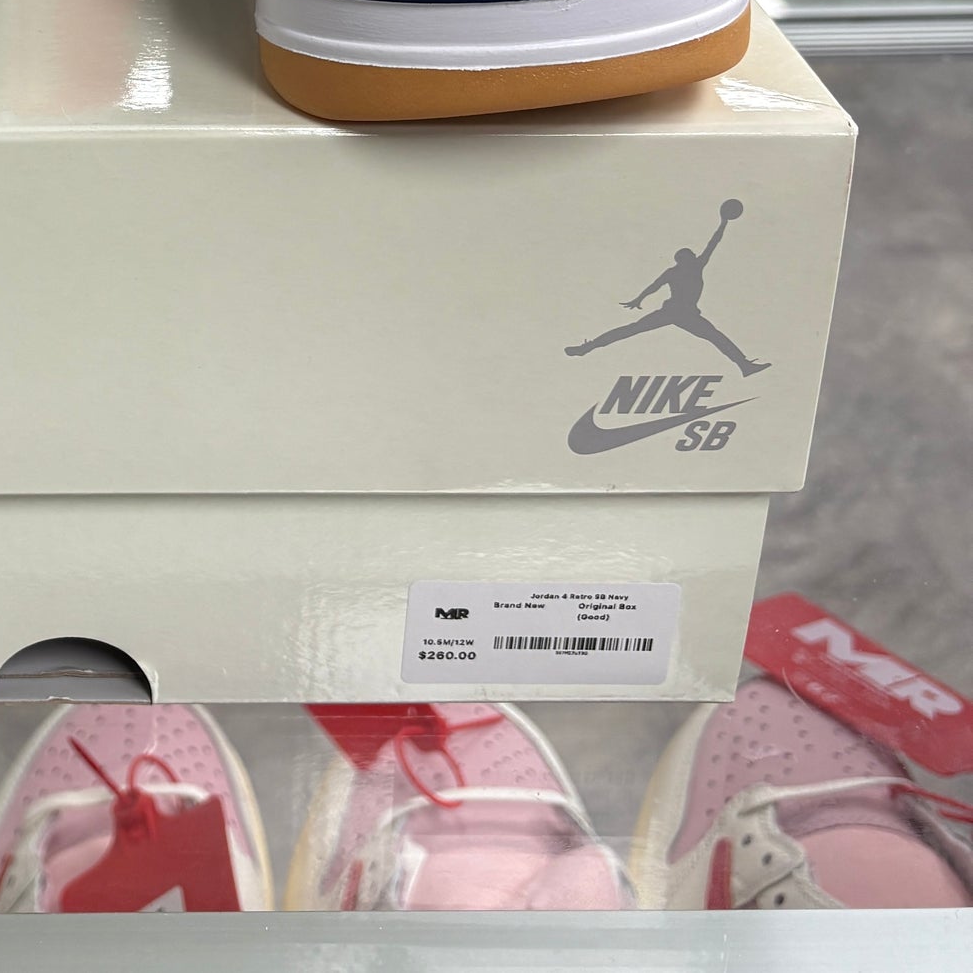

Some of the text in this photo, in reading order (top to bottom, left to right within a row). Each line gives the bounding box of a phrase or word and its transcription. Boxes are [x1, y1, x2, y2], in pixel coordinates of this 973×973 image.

[598, 375, 724, 415] NIKE
[674, 420, 737, 452] SB
[493, 601, 522, 609] Brand
[578, 602, 616, 611] Original
[576, 613, 610, 622] (Good)
[423, 638, 475, 647] 10.5M/12W
[418, 650, 477, 661] $260.00
